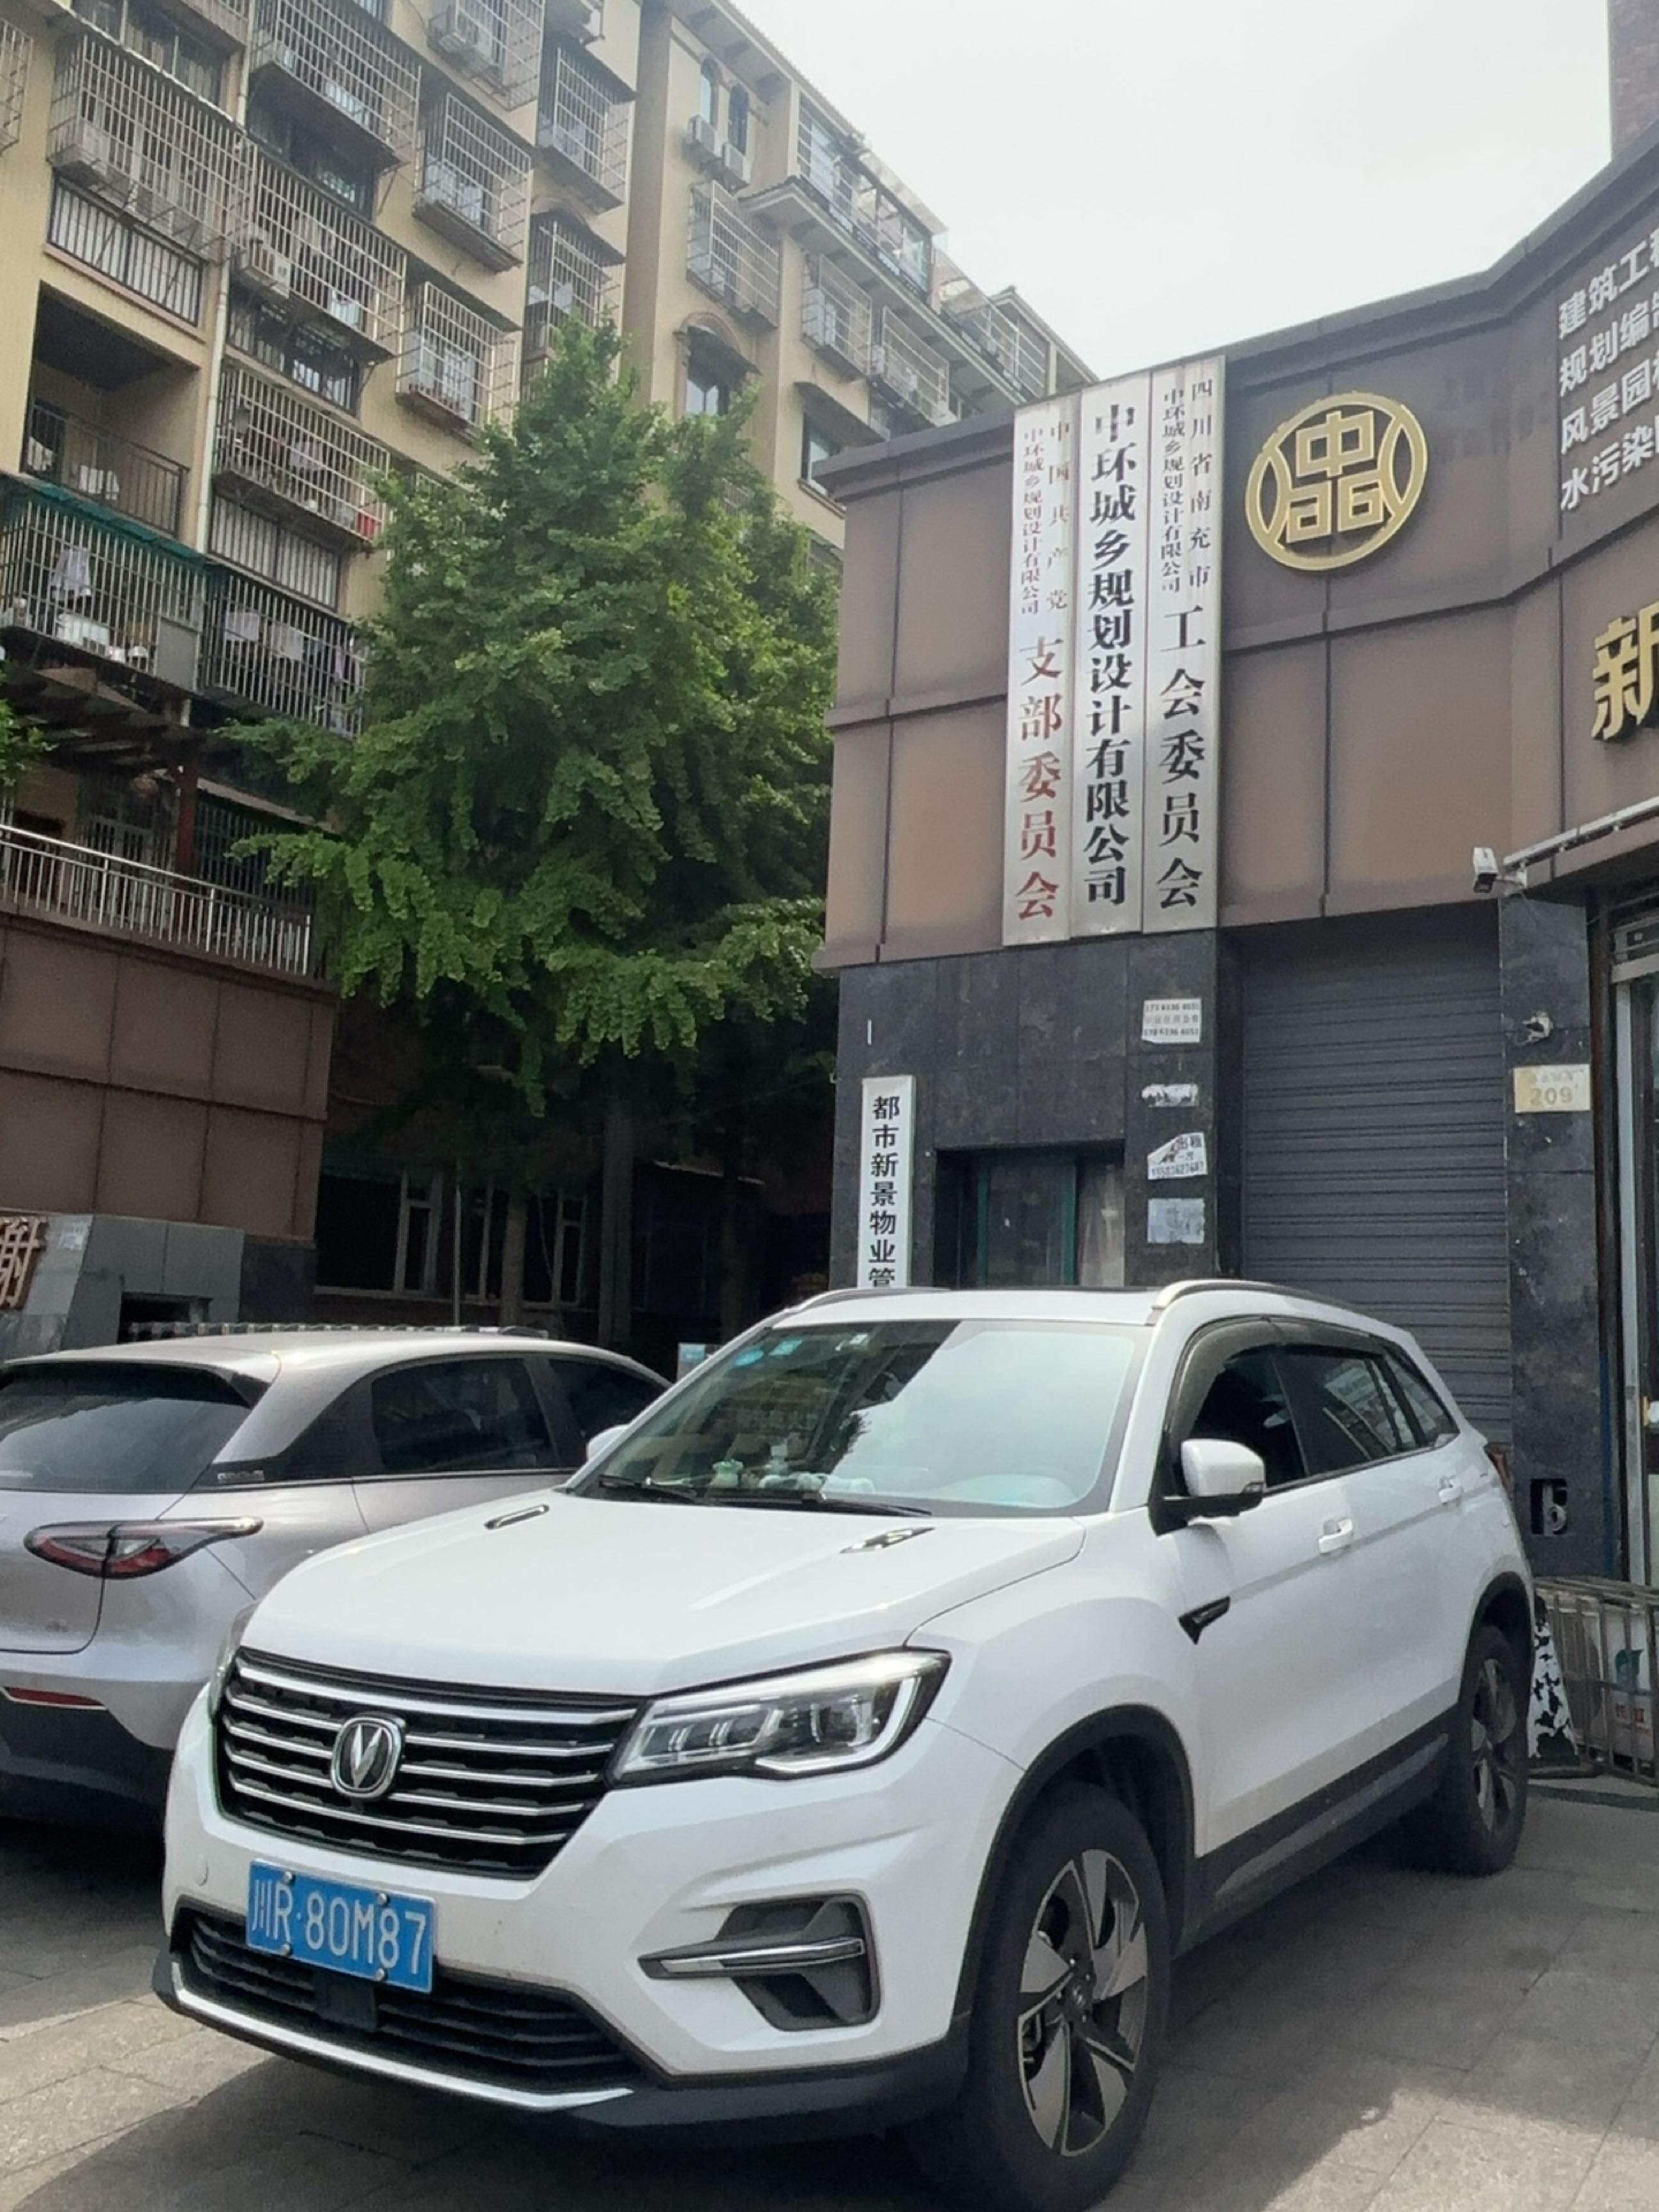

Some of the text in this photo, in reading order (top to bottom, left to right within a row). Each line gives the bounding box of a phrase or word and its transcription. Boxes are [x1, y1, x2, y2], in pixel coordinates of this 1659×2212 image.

[1021, 428, 1045, 615] 中环城乡规划设计有限公司
[1046, 421, 1070, 611] 中国共产党
[1160, 388, 1185, 593] 中环城乡规划设计有限公司
[1189, 379, 1213, 589] 四川省南充市
[1560, 415, 1659, 511] 水污染
[1083, 404, 1138, 906] 中环城乡规划设计有限公司
[1591, 600, 1659, 741] 新
[1015, 636, 1064, 920] 支部委员会
[1156, 605, 1206, 910] 工会委员会
[868, 1095, 900, 1288] 都市新景物业管
[1529, 1086, 1573, 1107] 209
